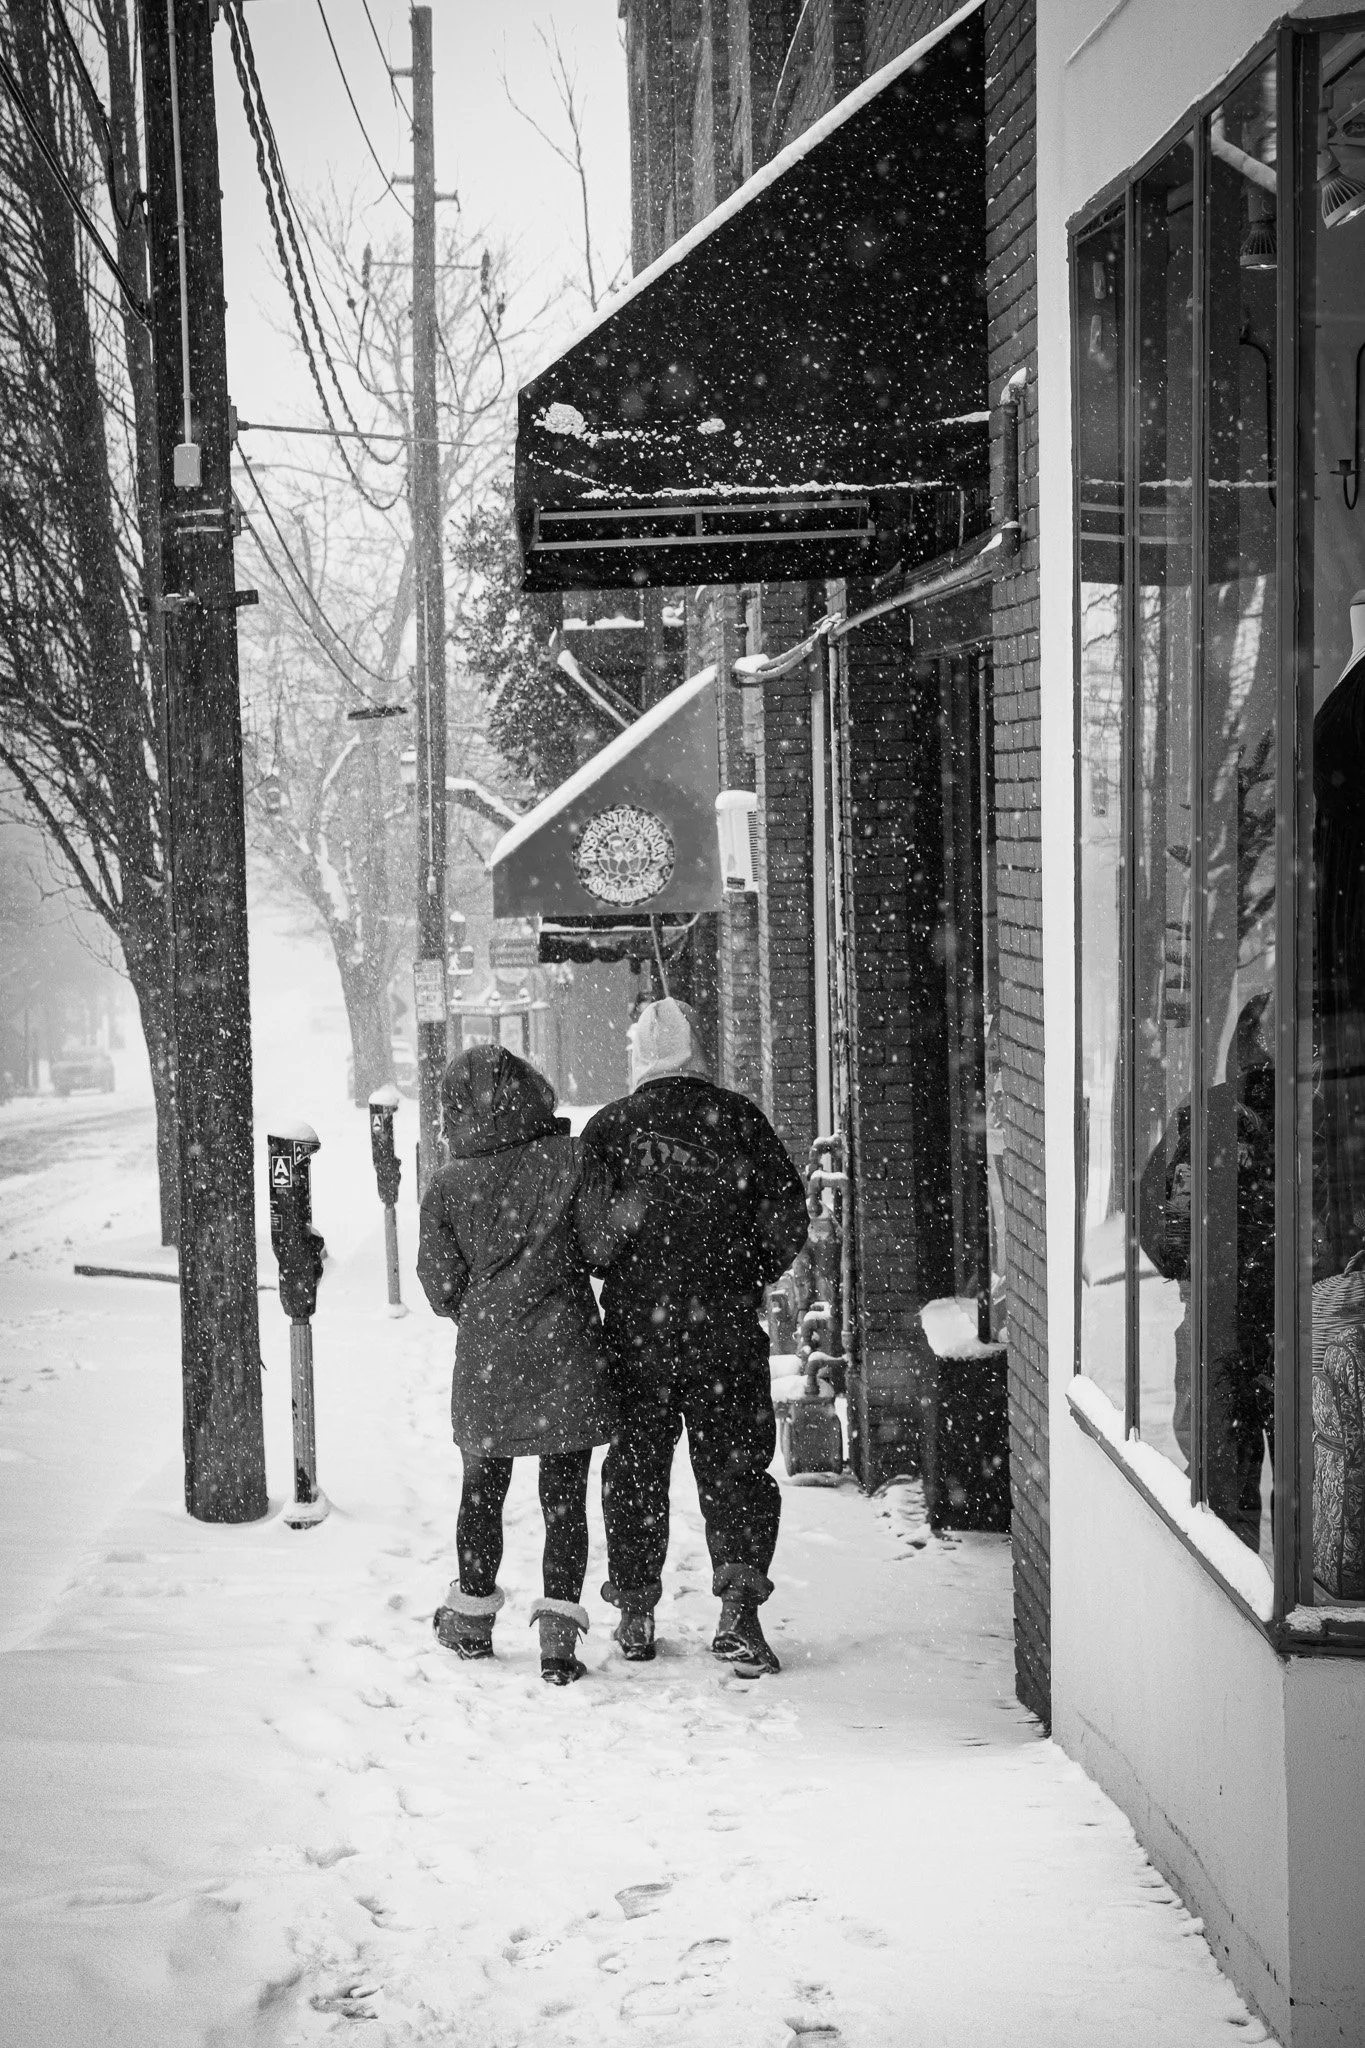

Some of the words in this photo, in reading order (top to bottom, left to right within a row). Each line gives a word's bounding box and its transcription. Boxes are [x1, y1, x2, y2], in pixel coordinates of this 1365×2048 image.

[579, 810, 623, 861] INSTANT
[625, 810, 669, 861] KARMA
[373, 1114, 381, 1126] A
[274, 1158, 289, 1177] A
